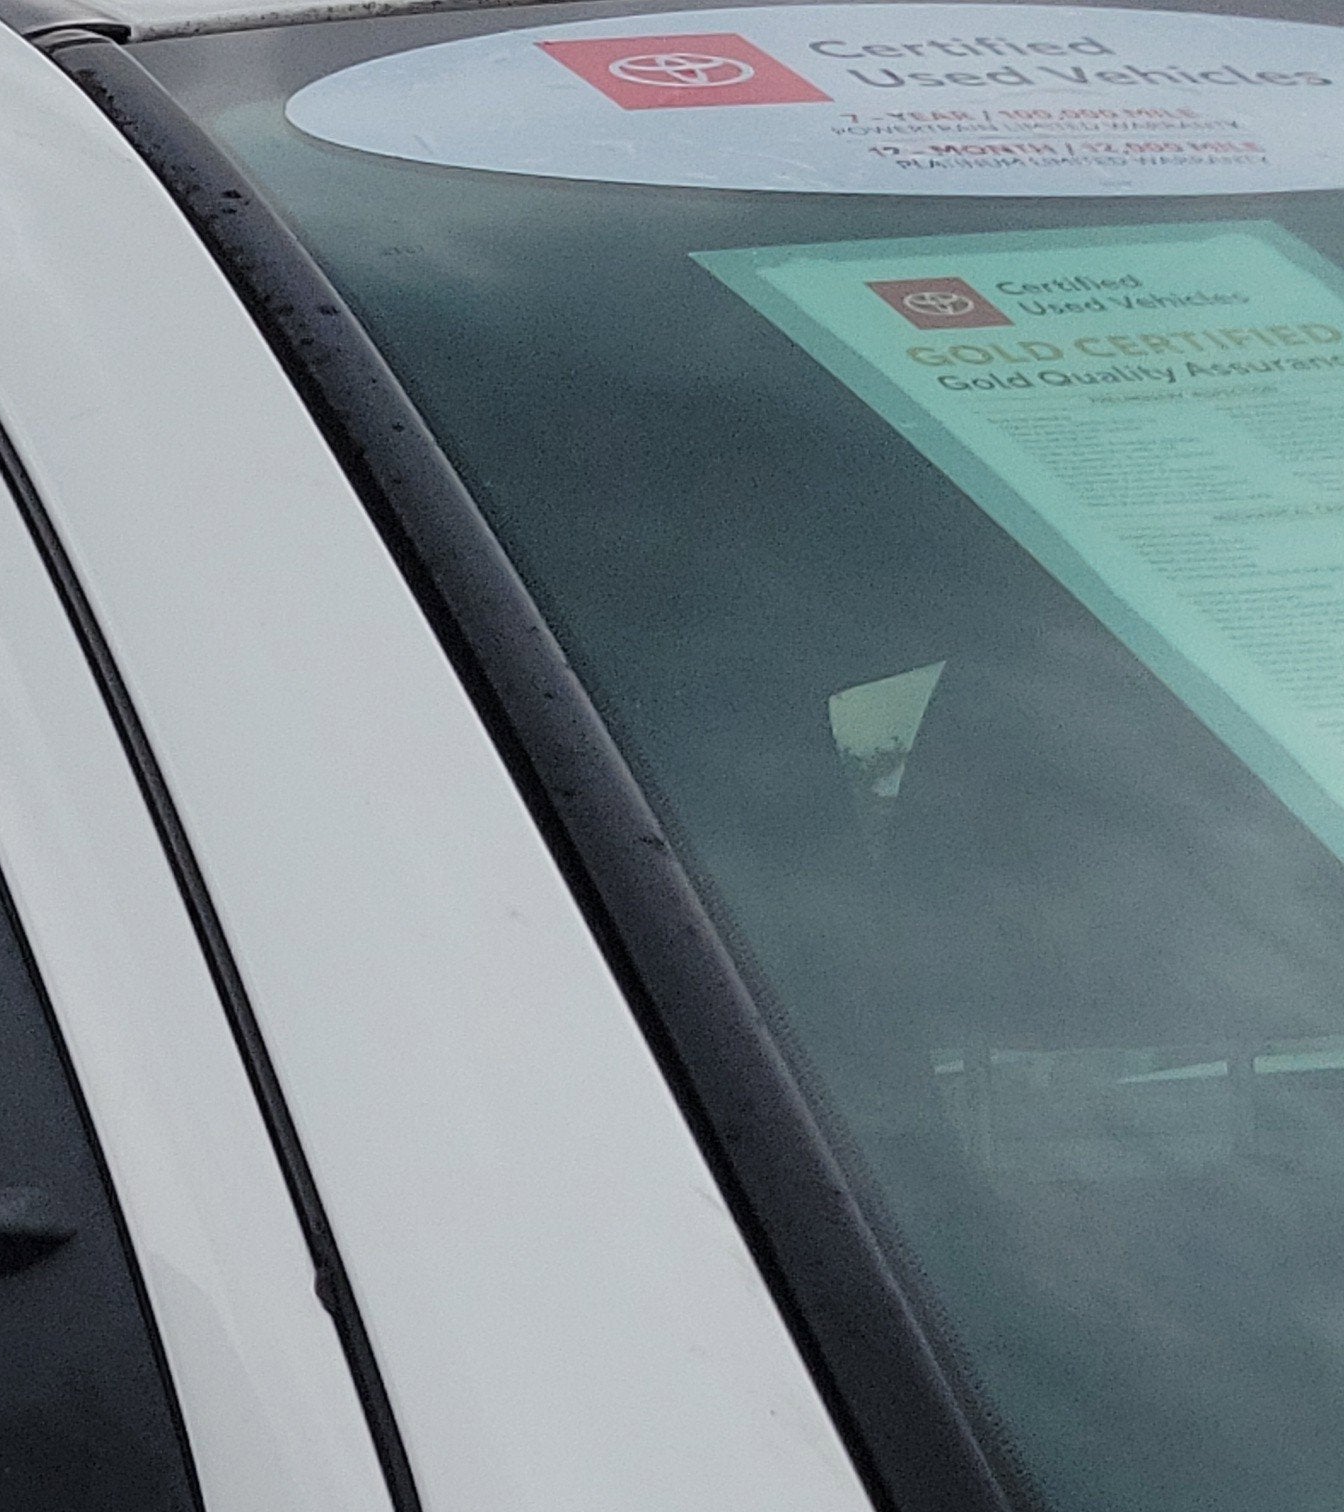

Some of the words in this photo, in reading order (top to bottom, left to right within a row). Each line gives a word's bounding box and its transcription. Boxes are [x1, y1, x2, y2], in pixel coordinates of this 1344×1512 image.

[809, 36, 1117, 59] Certified
[846, 65, 1035, 88] Used
[1037, 64, 1335, 86] Vehicles
[996, 274, 1144, 295] Certified
[1018, 298, 1107, 316] Used
[1109, 291, 1250, 310] Vehicles
[906, 341, 1064, 366] GOLD
[1073, 321, 1342, 358] CERTIFIED
[938, 372, 1034, 391] Gold
[1037, 364, 1177, 386] Quality
